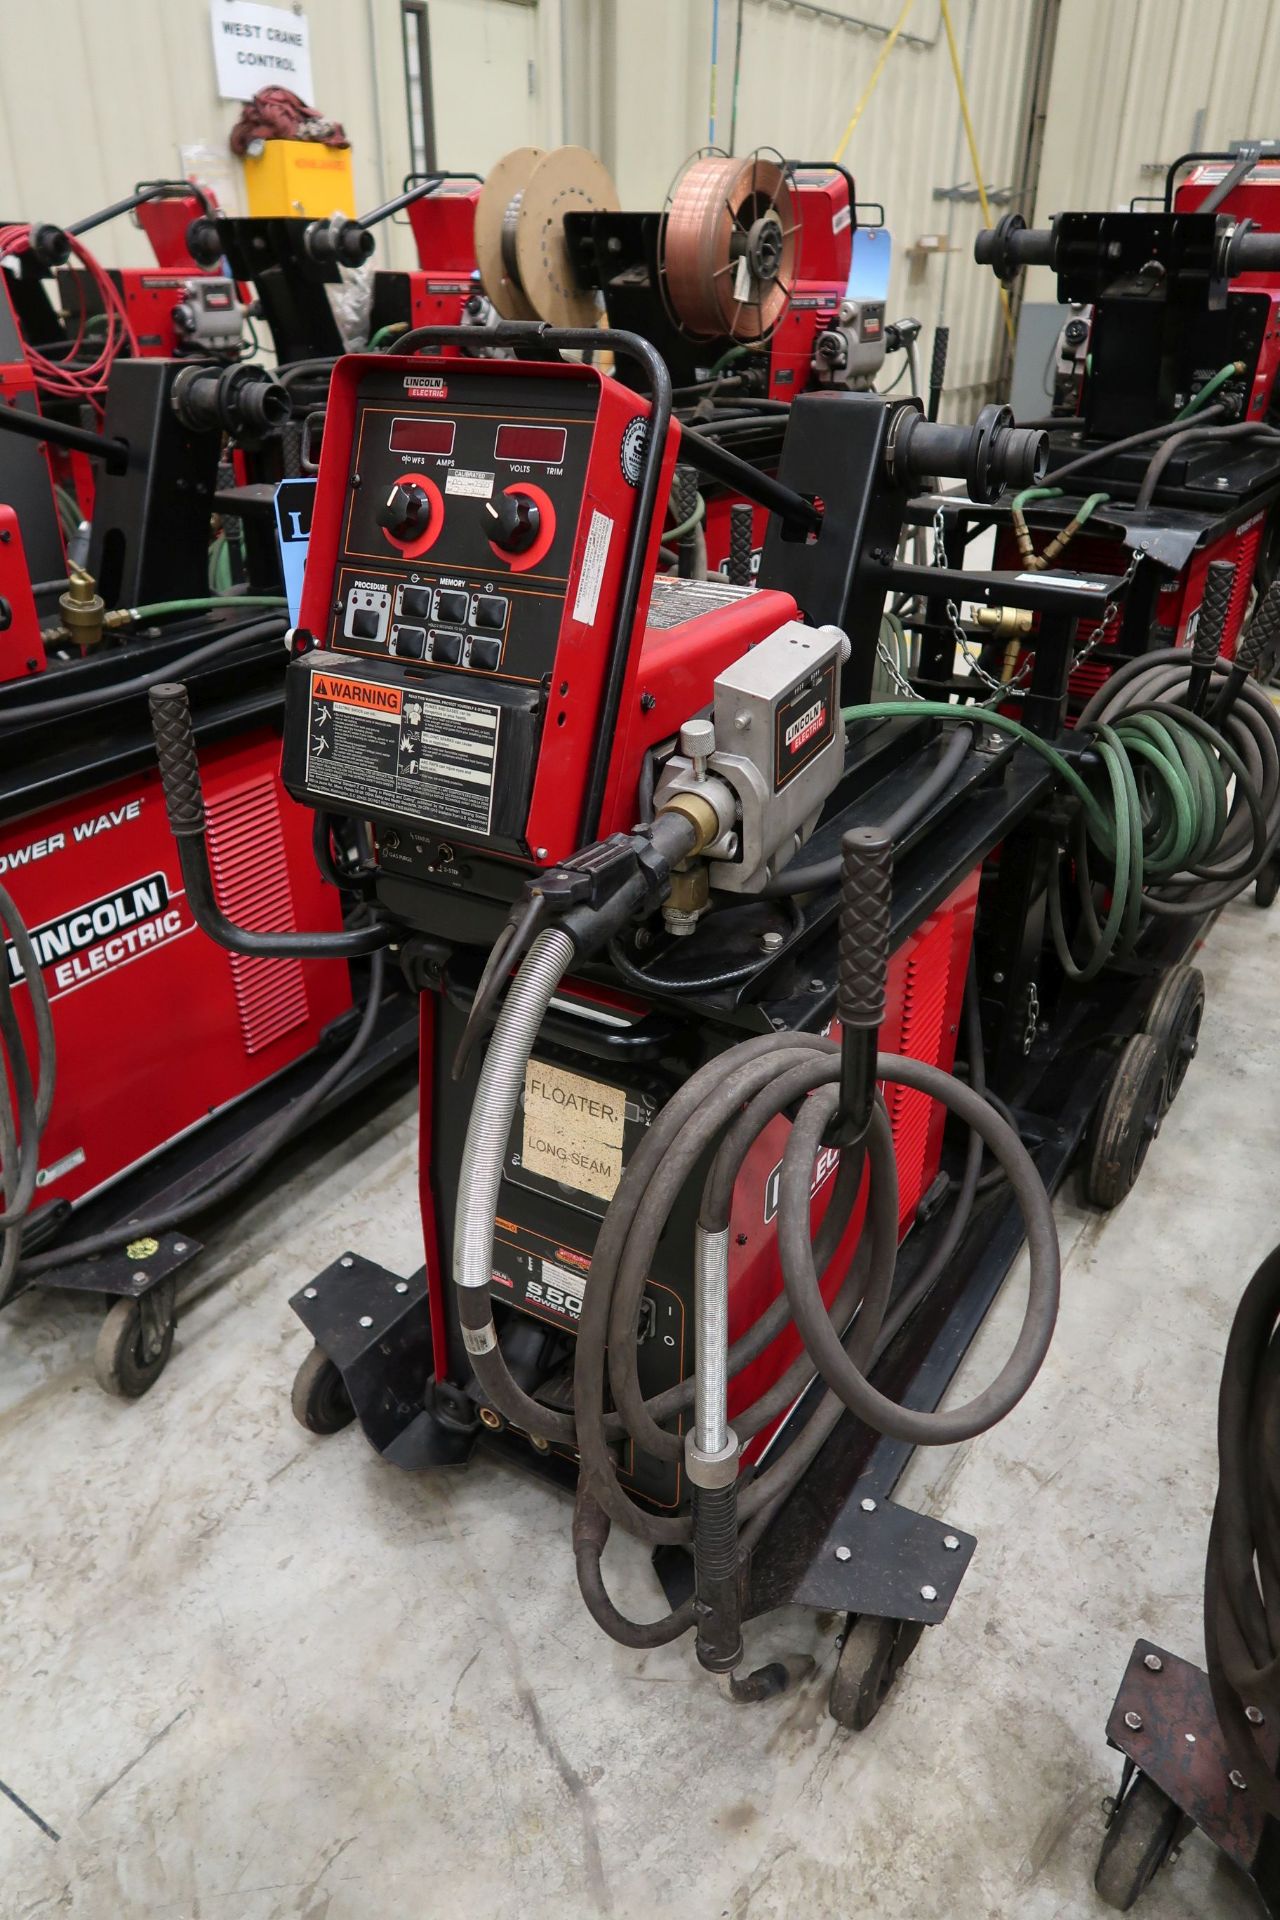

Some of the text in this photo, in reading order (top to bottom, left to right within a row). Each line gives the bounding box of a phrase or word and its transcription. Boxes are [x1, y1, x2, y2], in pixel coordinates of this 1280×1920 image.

[222, 21, 303, 47] WEST CRANE
[236, 51, 297, 72] CONTROL
[405, 378, 441, 388] LINCOLN
[412, 389, 444, 398] ELECTRIC
[436, 459, 455, 468] AMPS
[510, 464, 531, 474] VOLTS
[546, 467, 563, 476] TRIM
[354, 580, 388, 591] PROCEDURE
[440, 578, 466, 588] MEMORY
[434, 601, 440, 610] 2
[472, 606, 478, 615] 3
[391, 638, 397, 647] 4
[428, 644, 433, 653] 5
[465, 649, 471, 658] 6
[330, 681, 398, 709] WARNING
[788, 704, 820, 742] LINCOLN
[795, 716, 824, 748] ELECTRIC
[0, 800, 141, 875] OWER WAVE
[8, 881, 162, 978] LINCOLN
[55, 910, 183, 989] ELECTRIC
[528, 1136, 612, 1177] LONG SEAM
[525, 1291, 566, 1314] POWER
[526, 1281, 543, 1296] S
[545, 1286, 584, 1314] 50
